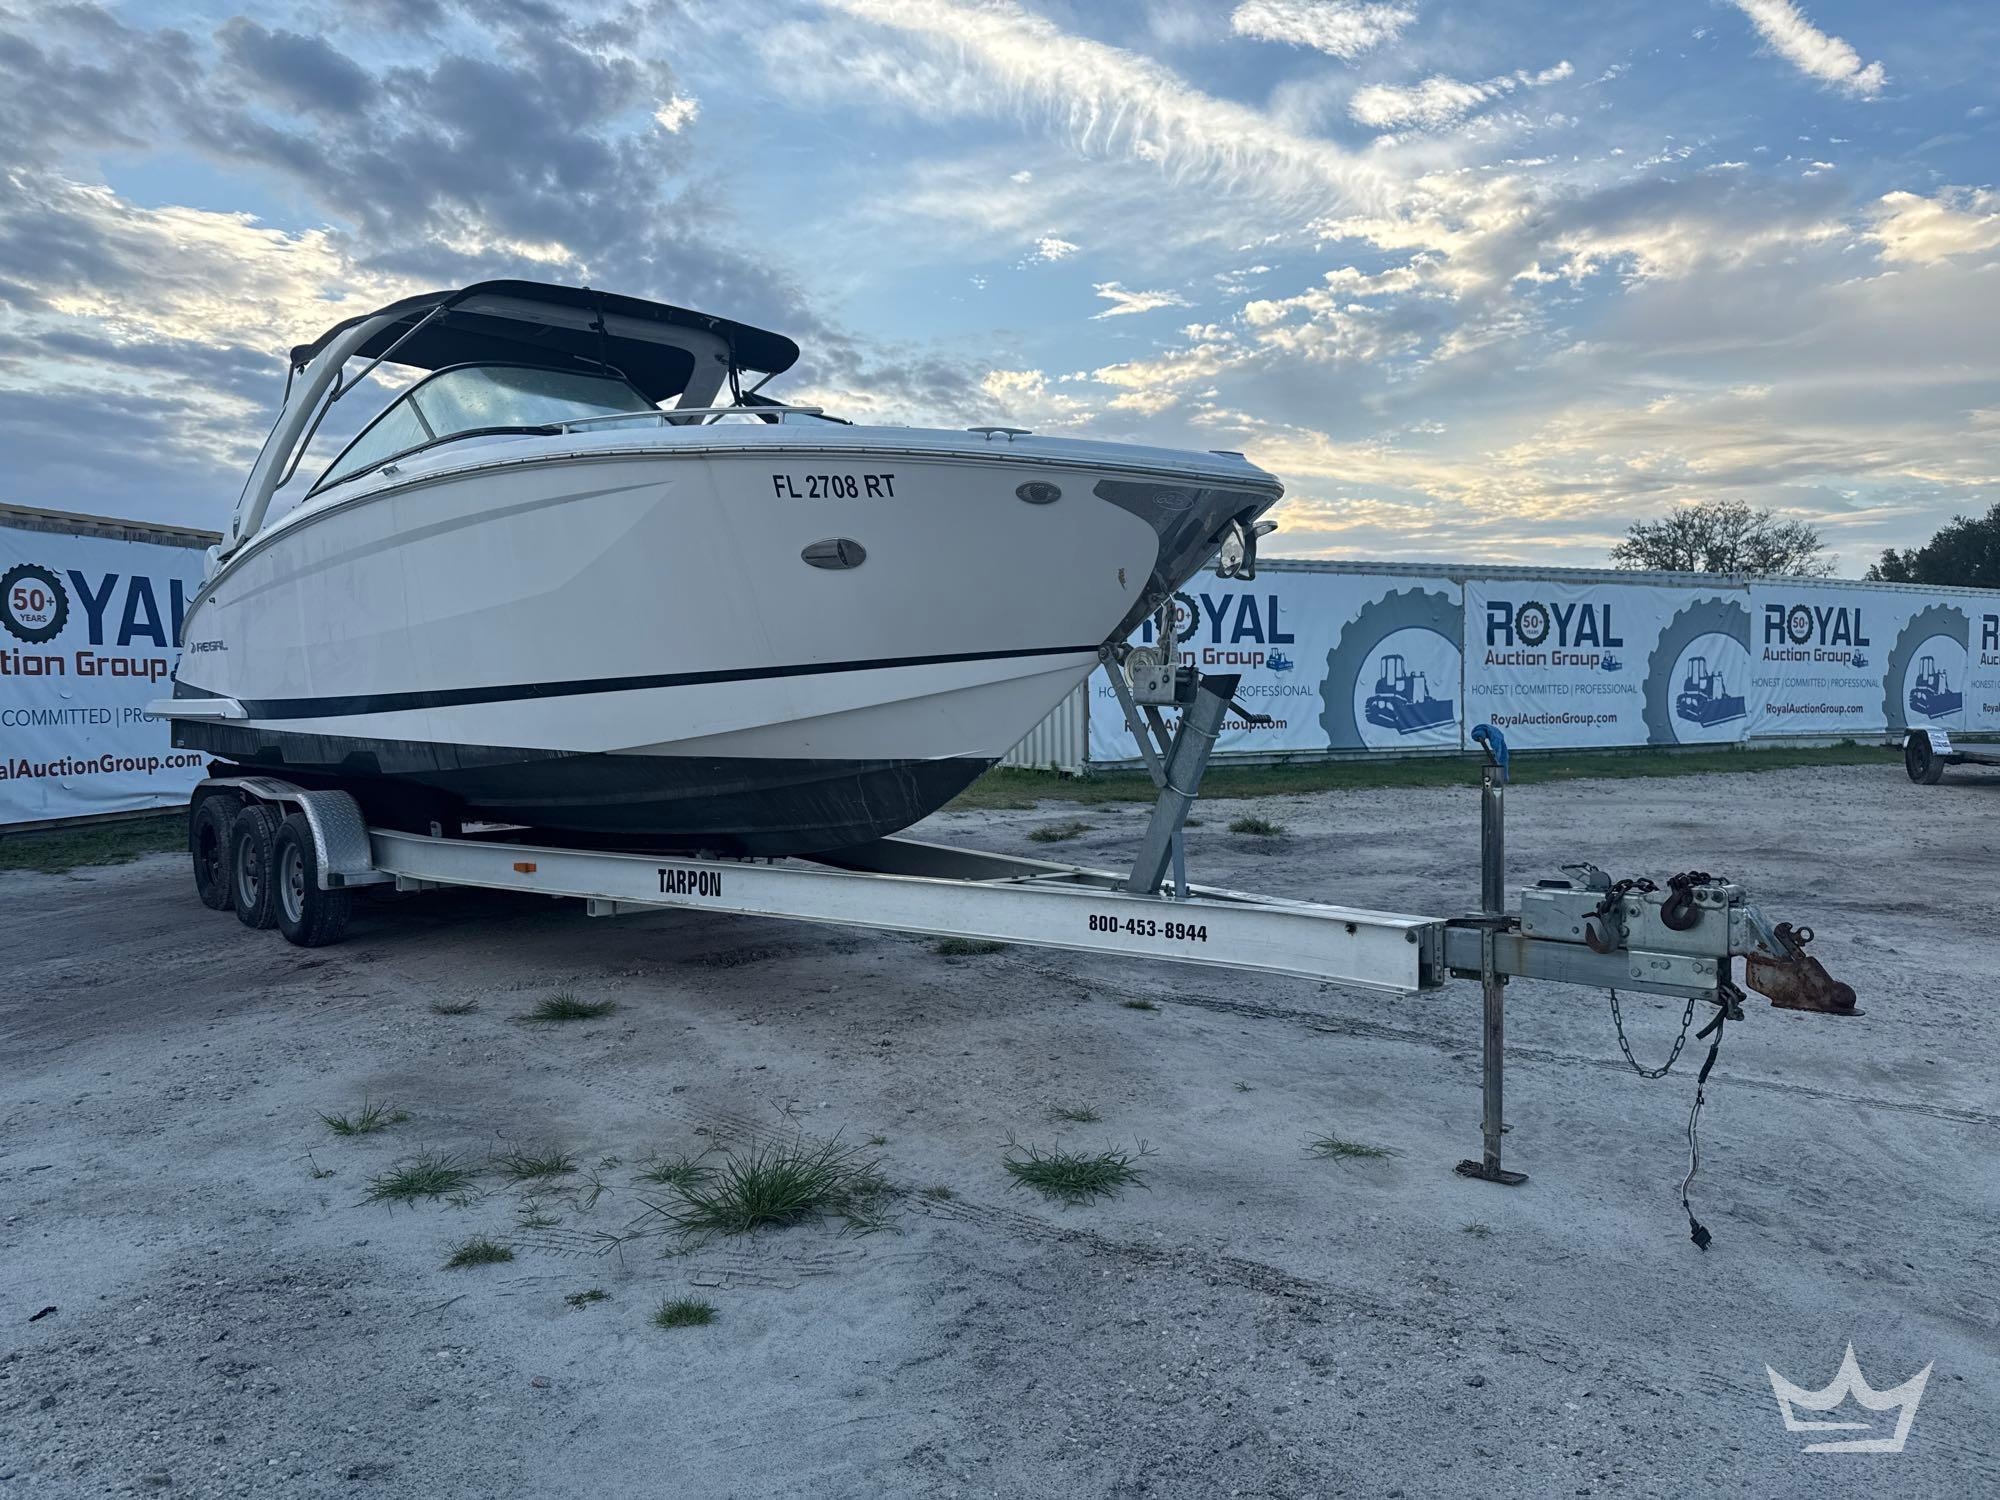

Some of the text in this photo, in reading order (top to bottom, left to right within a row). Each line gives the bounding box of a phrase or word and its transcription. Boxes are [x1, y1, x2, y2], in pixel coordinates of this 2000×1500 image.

[772, 473, 895, 499] FL 2708 RT
[20, 613, 47, 623] YEARS
[1486, 600, 1623, 648] ROYAL
[1764, 604, 1870, 647] ROYAL
[1203, 648, 1265, 670] Group
[1485, 649, 1599, 670] Auction Group
[1763, 647, 1851, 666] Auction Group
[76, 651, 167, 684] Group
[1472, 683, 1638, 695] HONEST COMMITTED PROFESSIONAL
[1751, 678, 1879, 689] HONEST COMMITTED PROFESSIONAL
[1, 707, 111, 727] COMMITTED
[1491, 711, 1617, 728] RoyalAuctionGroup.com
[1766, 703, 1864, 716] RoyalAuctionGroup.com
[658, 868, 721, 897] TARPON
[1089, 914, 1208, 942] 800-453-8944
